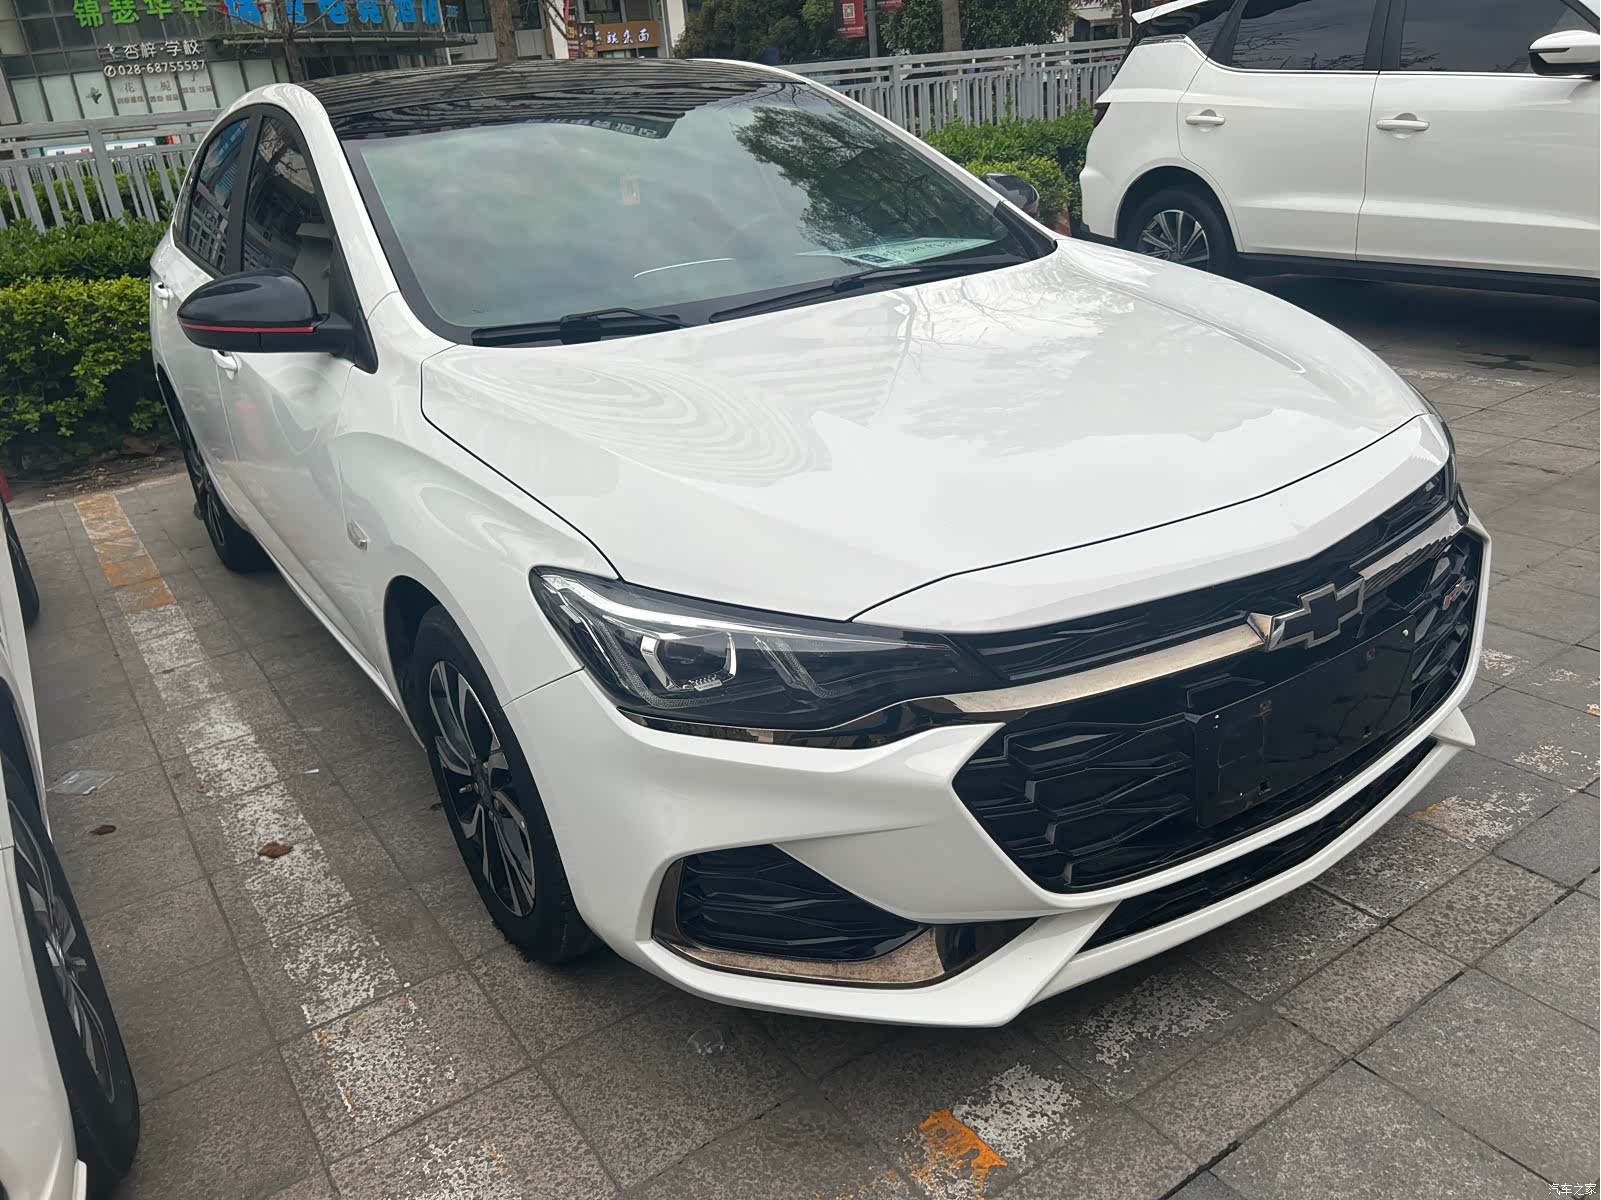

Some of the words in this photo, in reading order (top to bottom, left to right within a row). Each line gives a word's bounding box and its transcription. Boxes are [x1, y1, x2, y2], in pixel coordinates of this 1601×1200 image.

[73, 0, 207, 27] 锦瑟华年
[118, 60, 205, 76] 028-68755587
